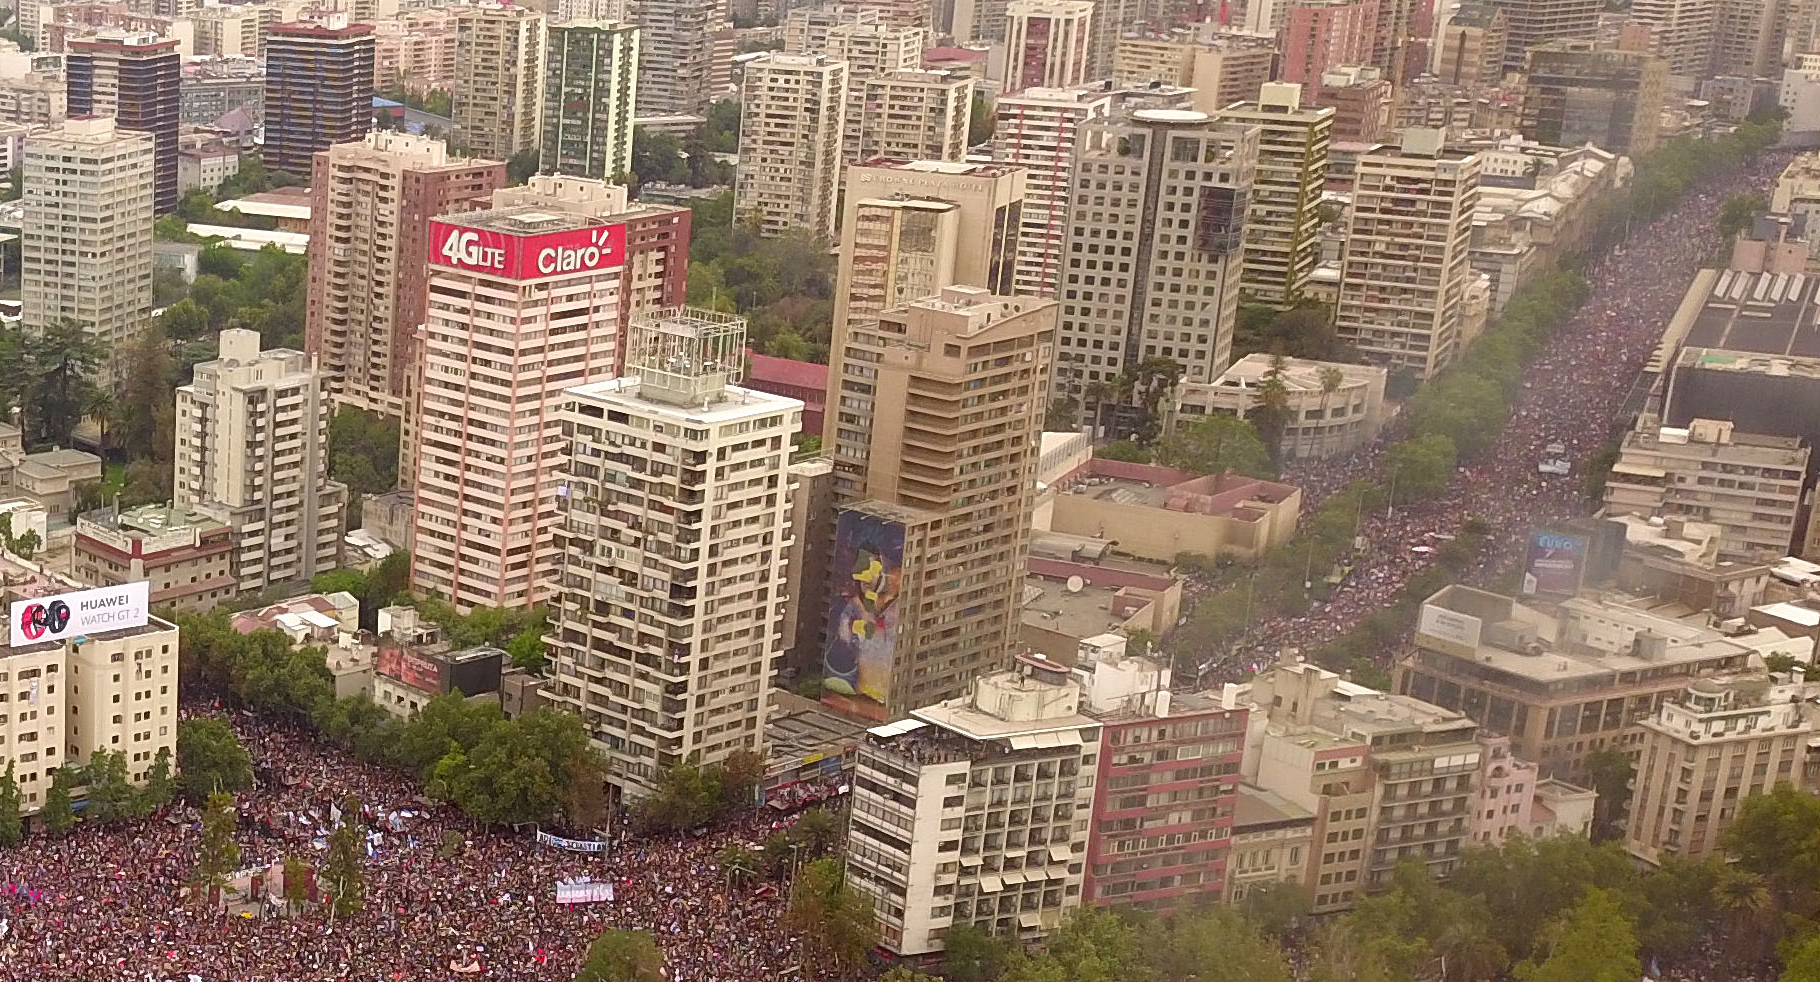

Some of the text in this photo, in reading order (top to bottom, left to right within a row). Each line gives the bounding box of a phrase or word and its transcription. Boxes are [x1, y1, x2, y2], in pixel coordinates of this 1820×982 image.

[537, 244, 601, 274] Claro
[80, 594, 129, 612] HUAWEI
[80, 607, 140, 627] WATCH GT 2
